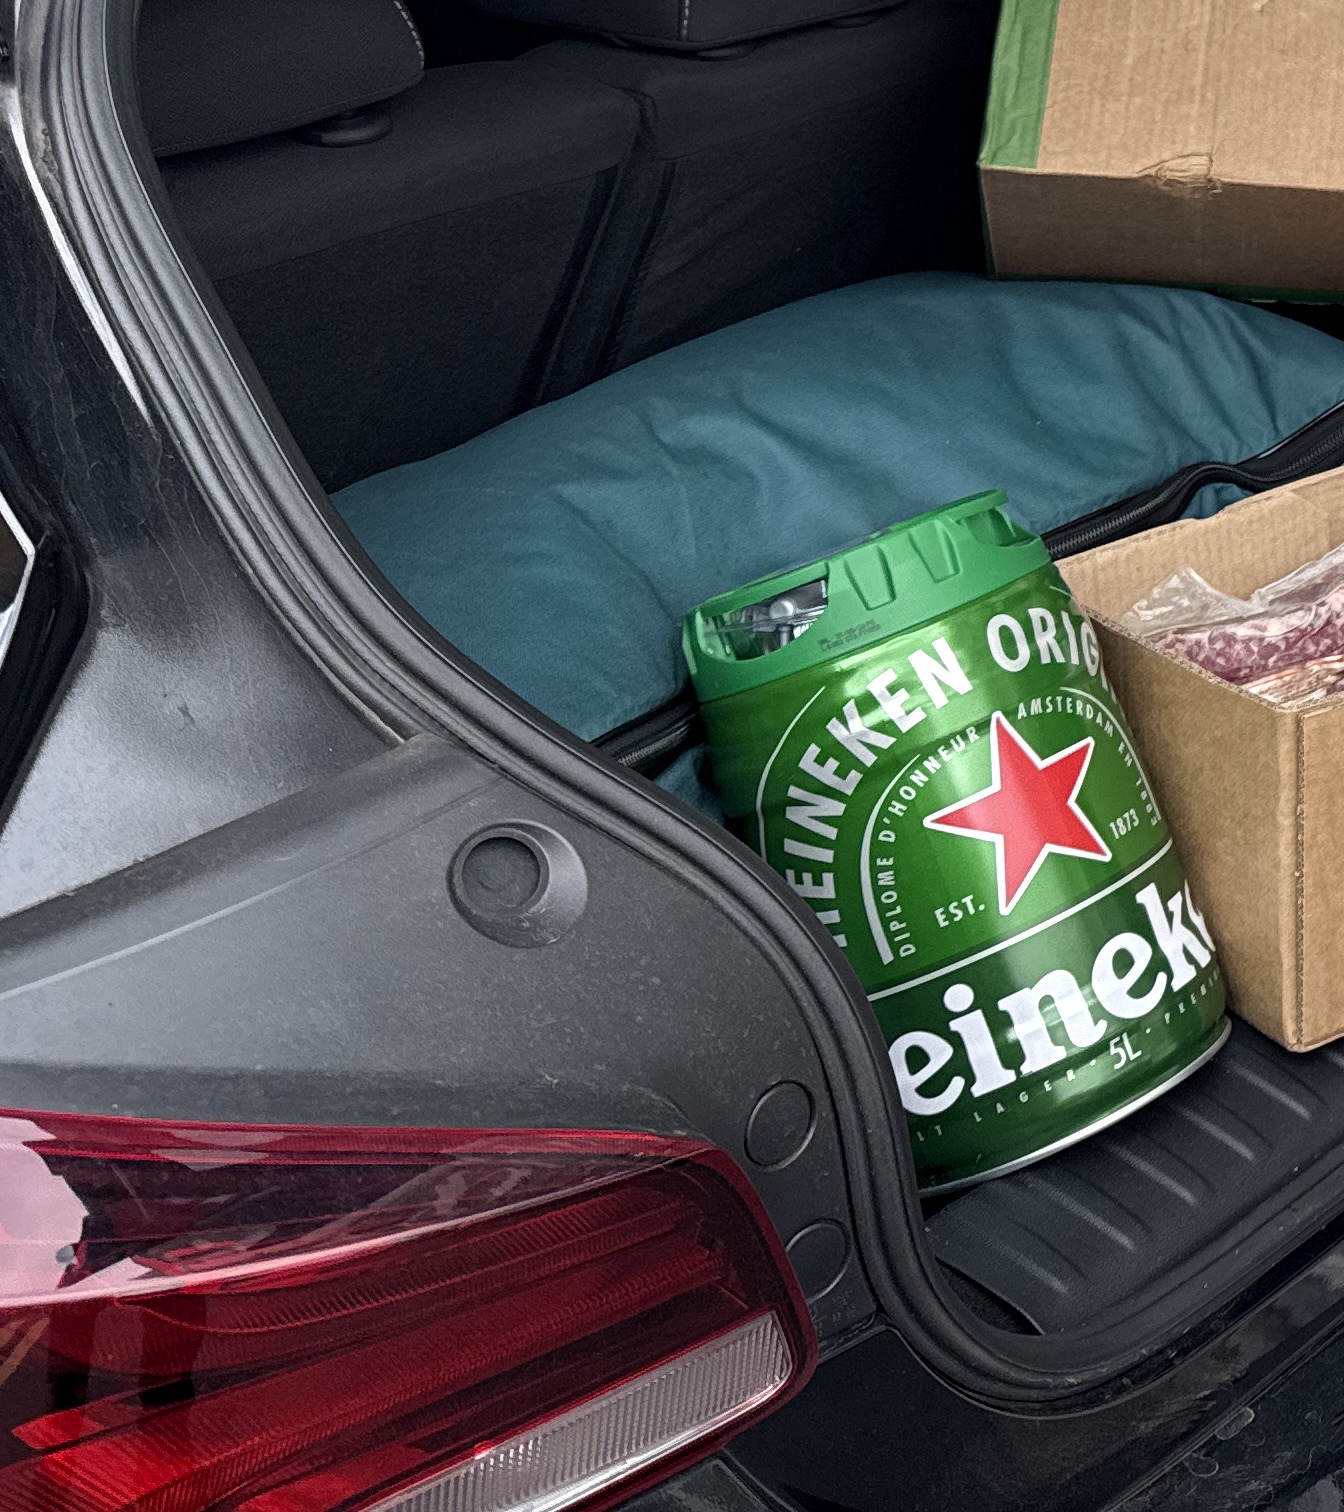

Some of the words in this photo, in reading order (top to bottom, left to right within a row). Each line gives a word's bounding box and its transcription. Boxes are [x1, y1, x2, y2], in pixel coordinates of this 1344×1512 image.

[1017, 697, 1116, 738] AMSTERDAM
[878, 726, 981, 843] D'HONNEUR
[876, 856, 916, 958] DIPLOME
[934, 893, 985, 929] EST.
[1109, 808, 1140, 840] 1873
[974, 1068, 1077, 1124] LAGER
[1109, 1032, 1141, 1070] 5L
